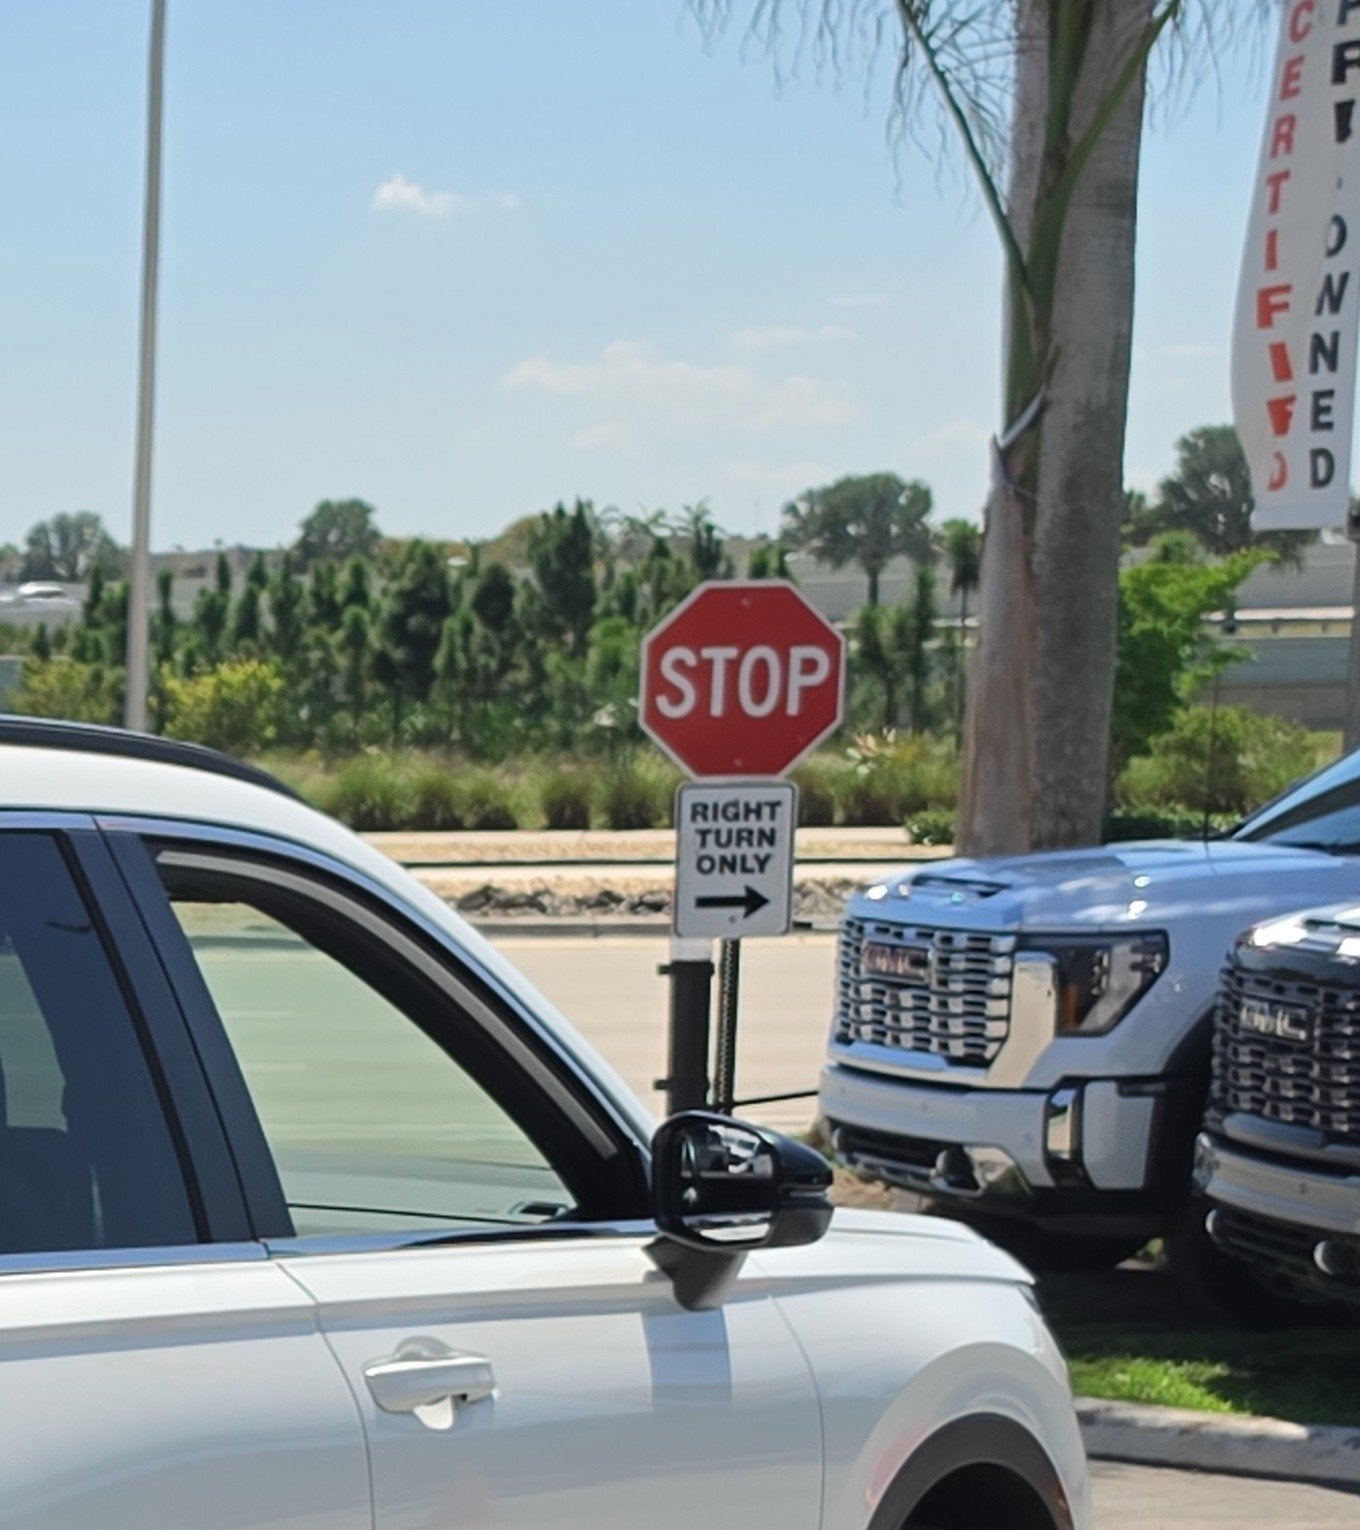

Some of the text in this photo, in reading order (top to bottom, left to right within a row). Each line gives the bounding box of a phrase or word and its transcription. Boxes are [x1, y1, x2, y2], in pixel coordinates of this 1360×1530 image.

[655, 644, 831, 719] STOP
[690, 800, 781, 823] RIGHT
[695, 828, 776, 848] TURN
[696, 853, 772, 875] ONLY
